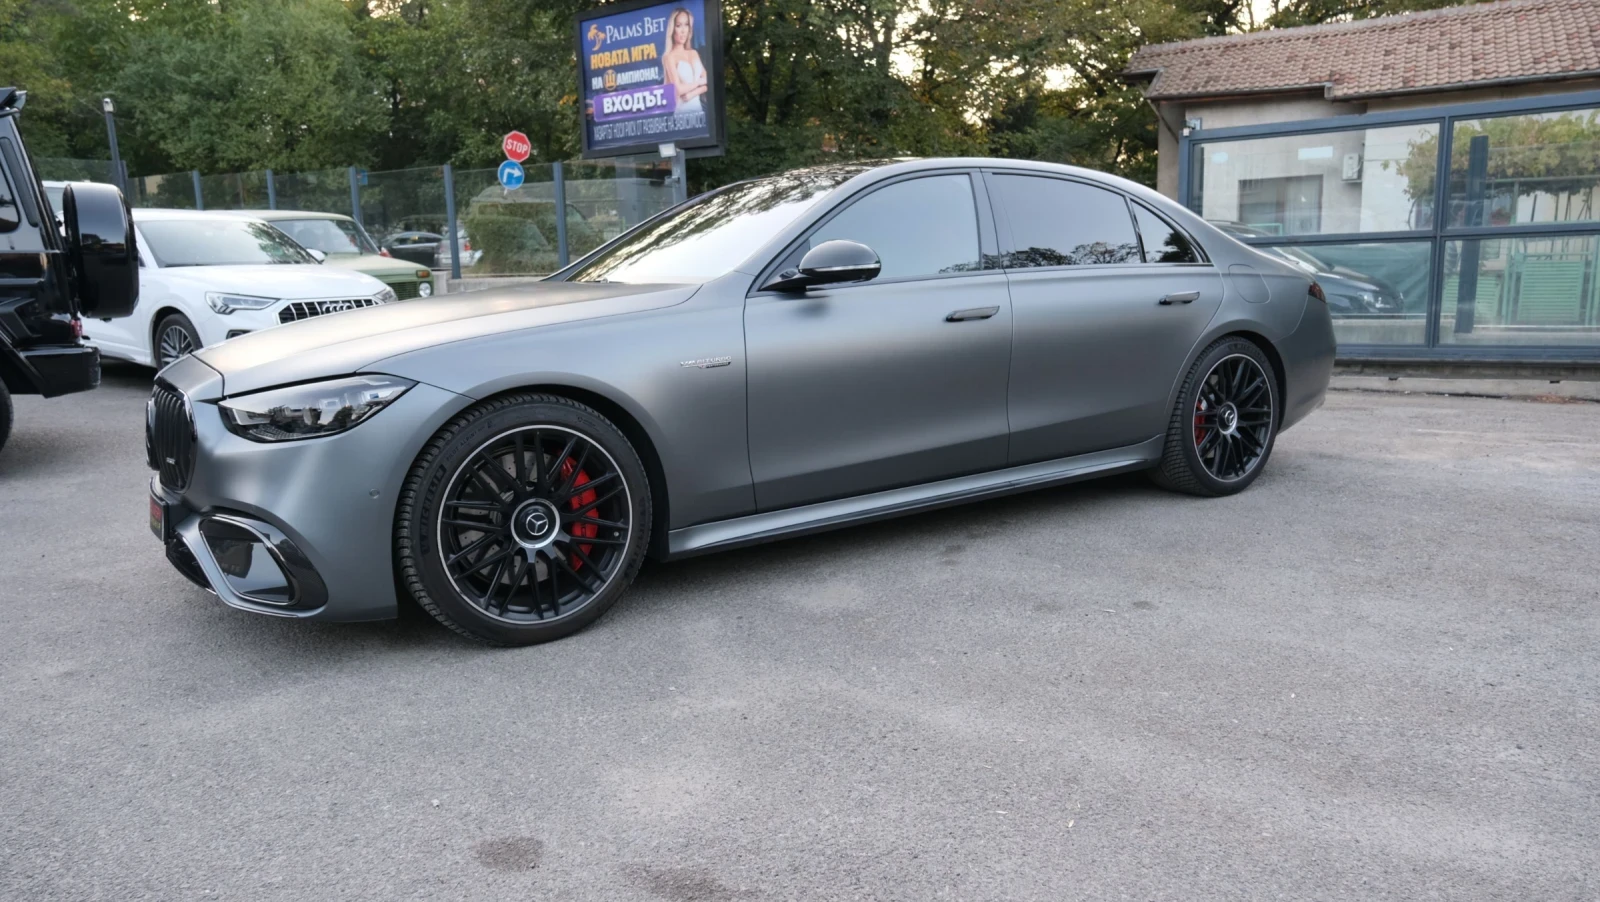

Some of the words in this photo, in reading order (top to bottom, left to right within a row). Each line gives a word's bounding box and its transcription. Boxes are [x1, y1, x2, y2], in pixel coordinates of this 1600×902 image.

[605, 22, 643, 44] PALMS
[643, 17, 666, 36] BET
[590, 48, 630, 70] НОВАТА
[631, 43, 657, 63] ИГРА
[592, 75, 604, 90] НА
[603, 89, 667, 114] ВХОДЪТ.
[506, 138, 528, 154] STOP
